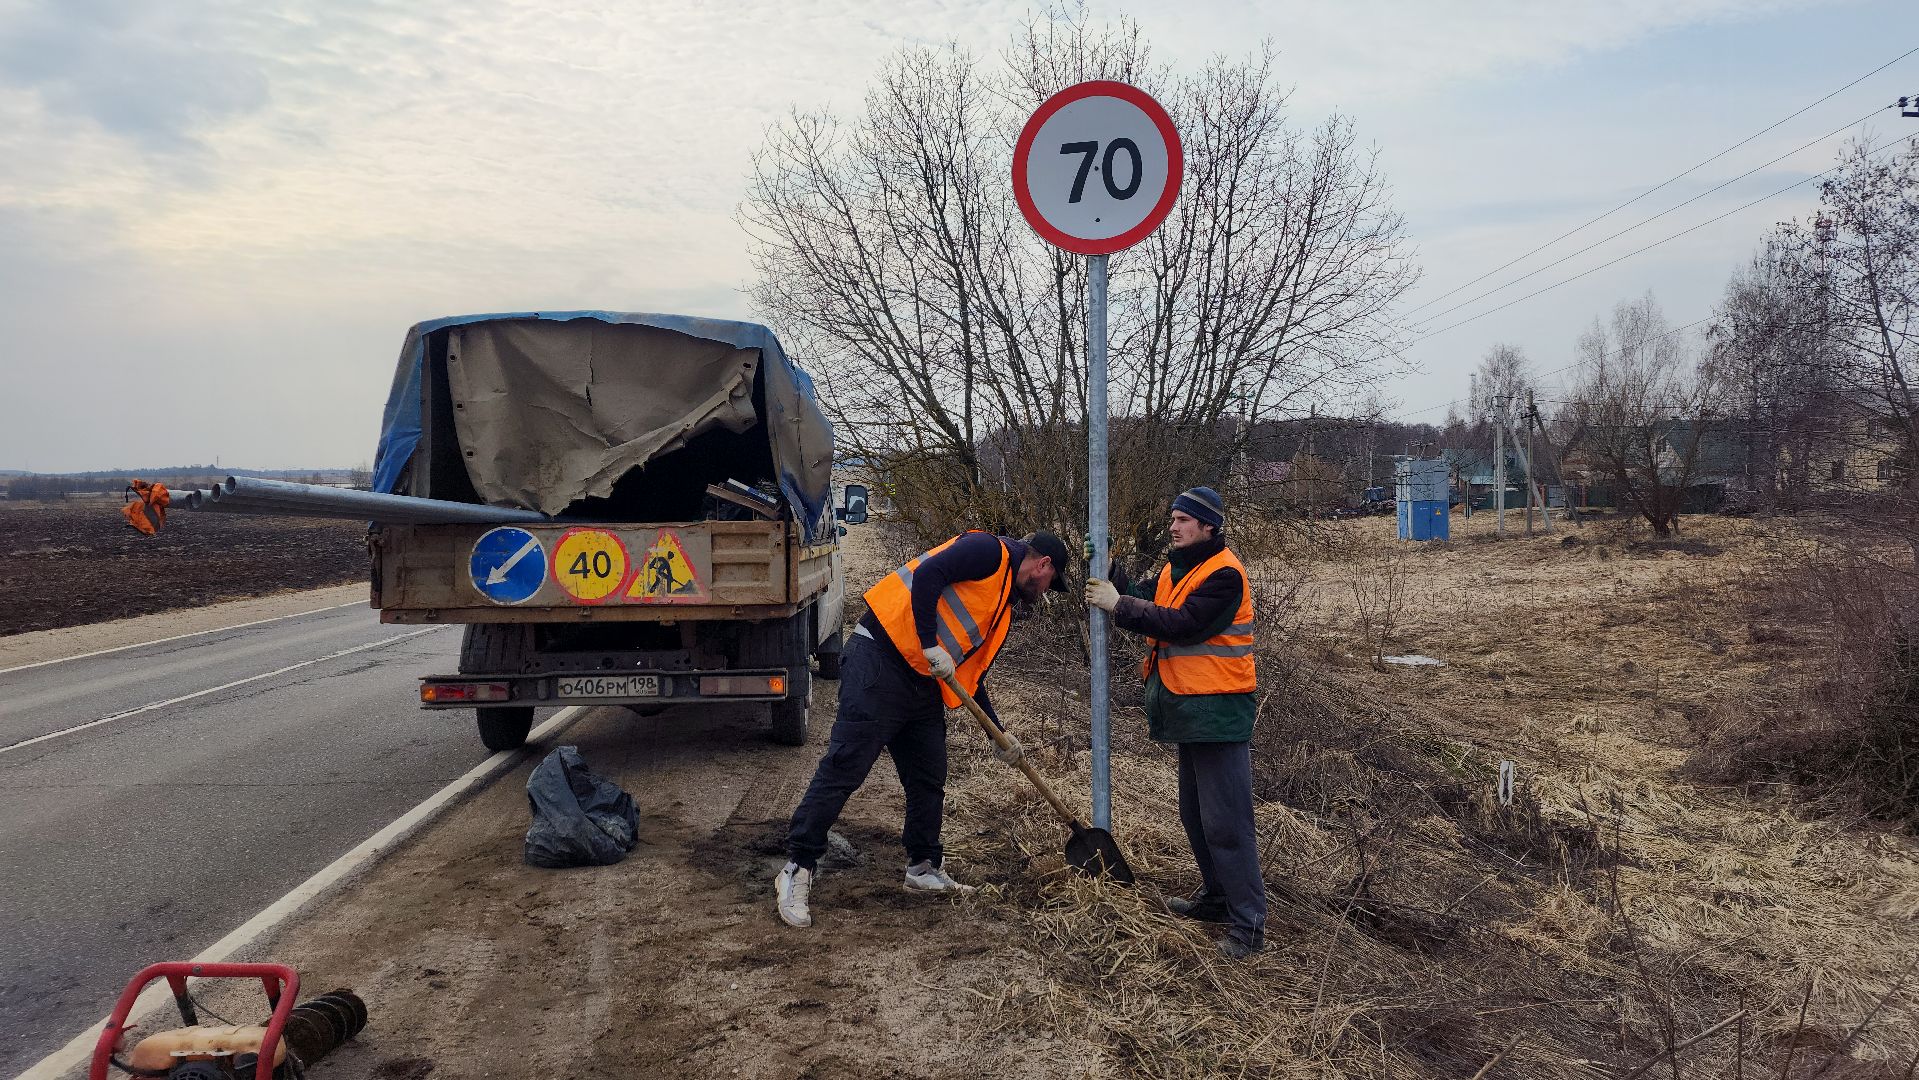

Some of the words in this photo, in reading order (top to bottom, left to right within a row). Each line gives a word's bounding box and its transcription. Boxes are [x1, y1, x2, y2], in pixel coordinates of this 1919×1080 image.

[1060, 137, 1143, 203] 70
[569, 550, 612, 579] 40
[630, 677, 654, 690] 198
